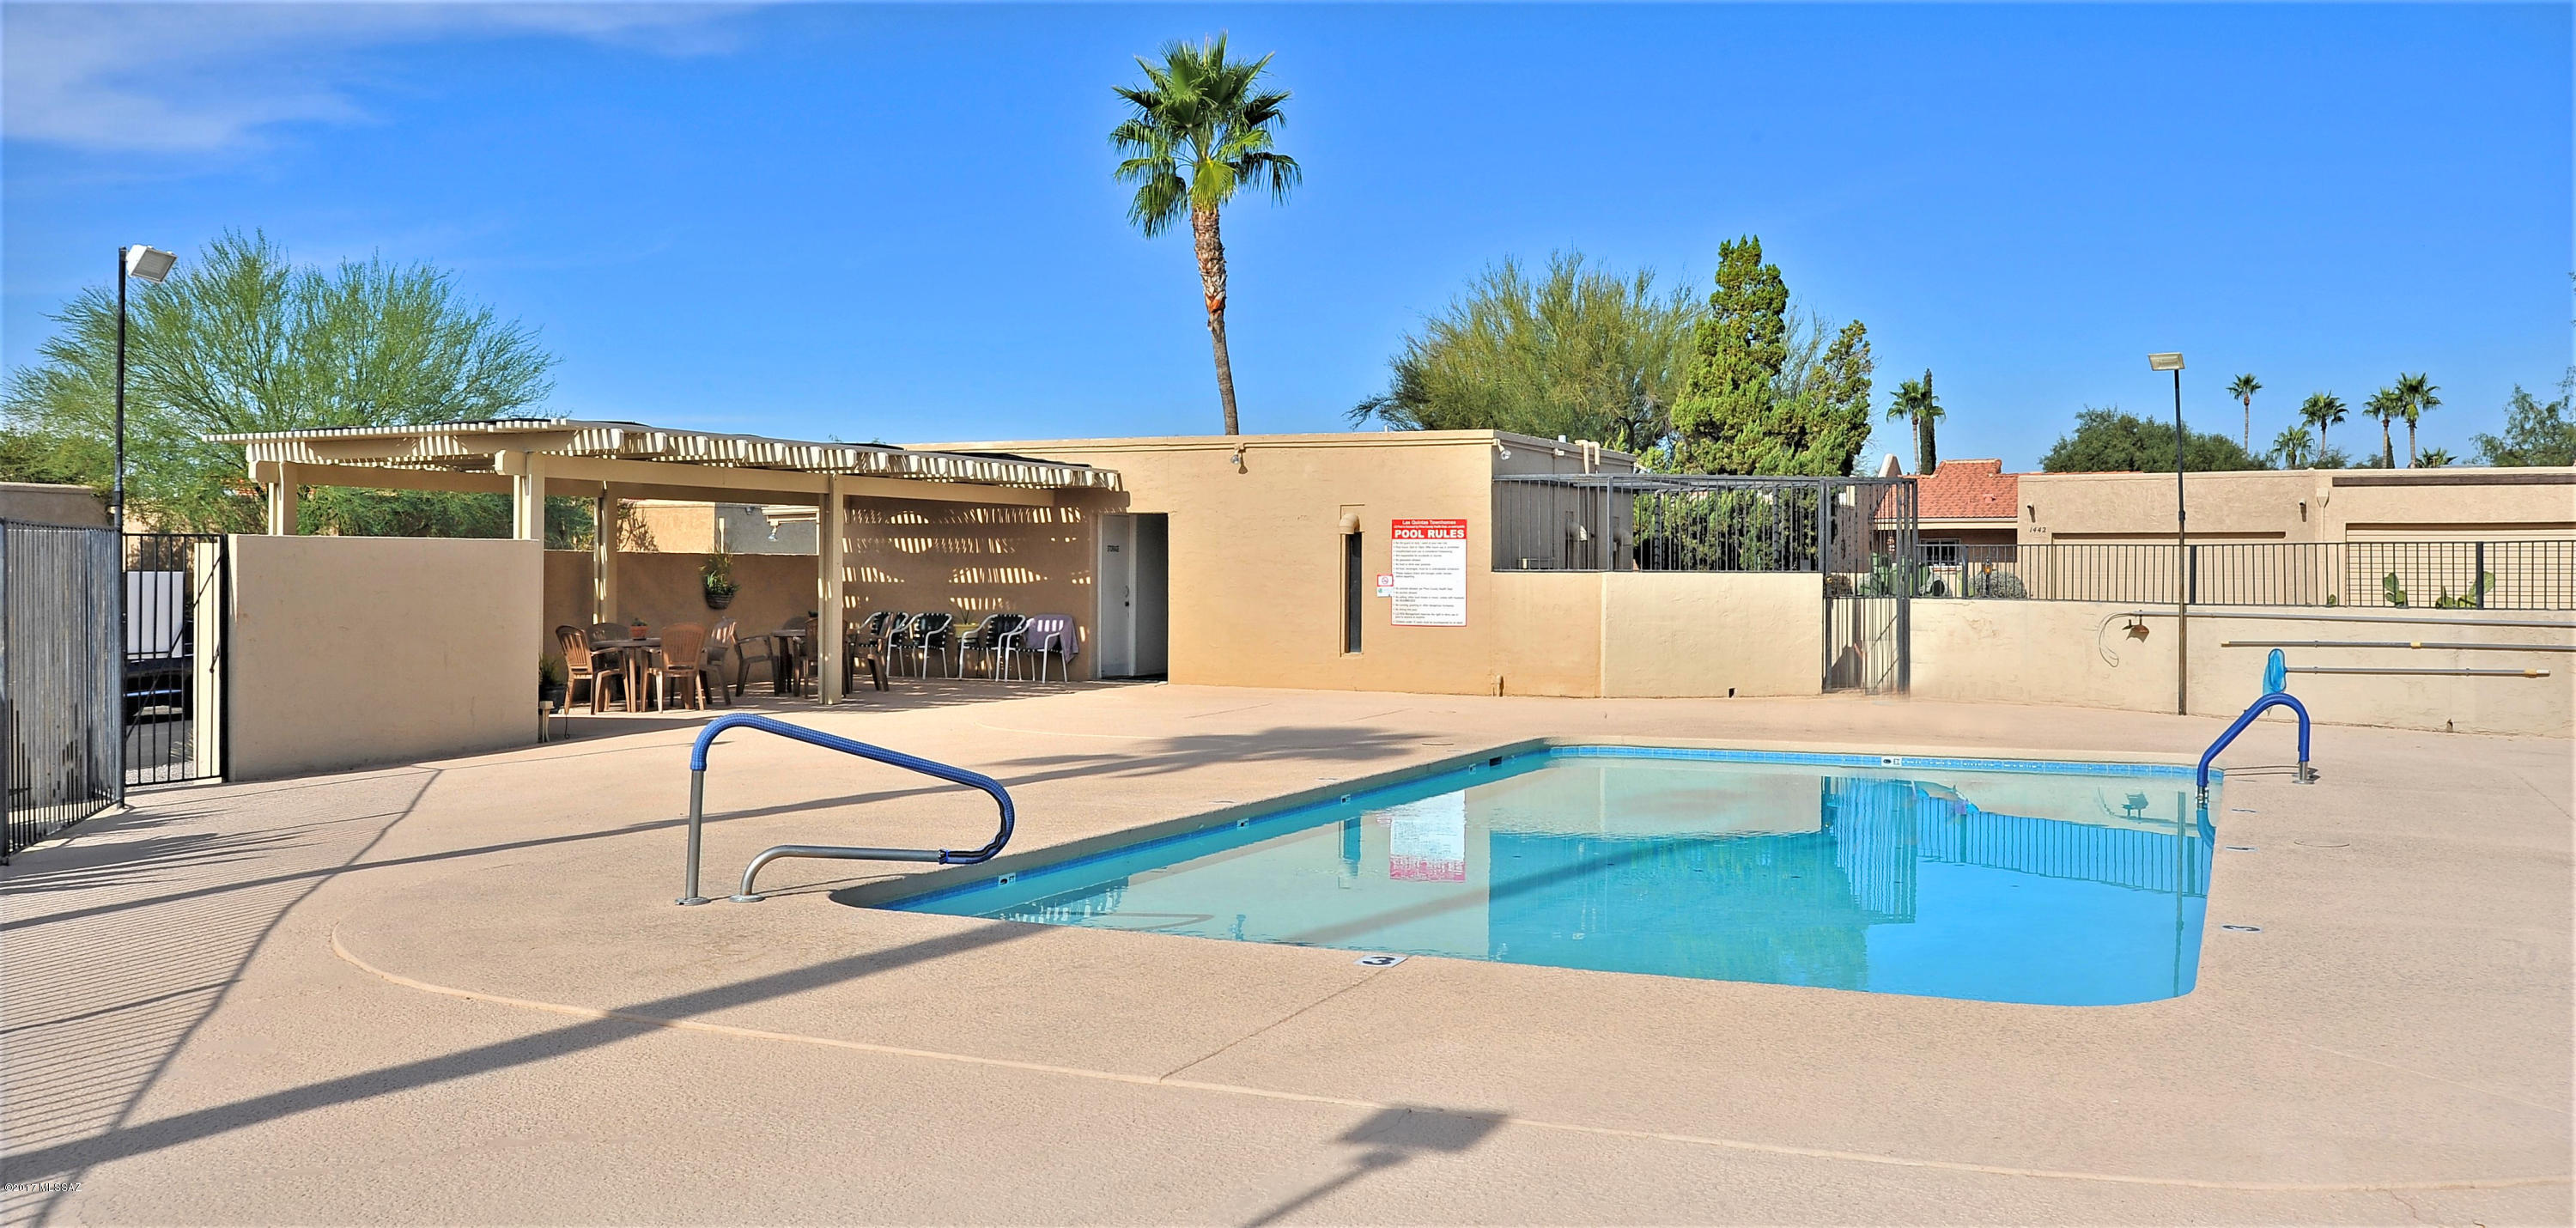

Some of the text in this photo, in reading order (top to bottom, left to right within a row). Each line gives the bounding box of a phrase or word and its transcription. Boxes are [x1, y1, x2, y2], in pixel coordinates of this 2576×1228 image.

[1394, 529, 1465, 538] POOL RULES
[1362, 956, 1396, 966] 3
